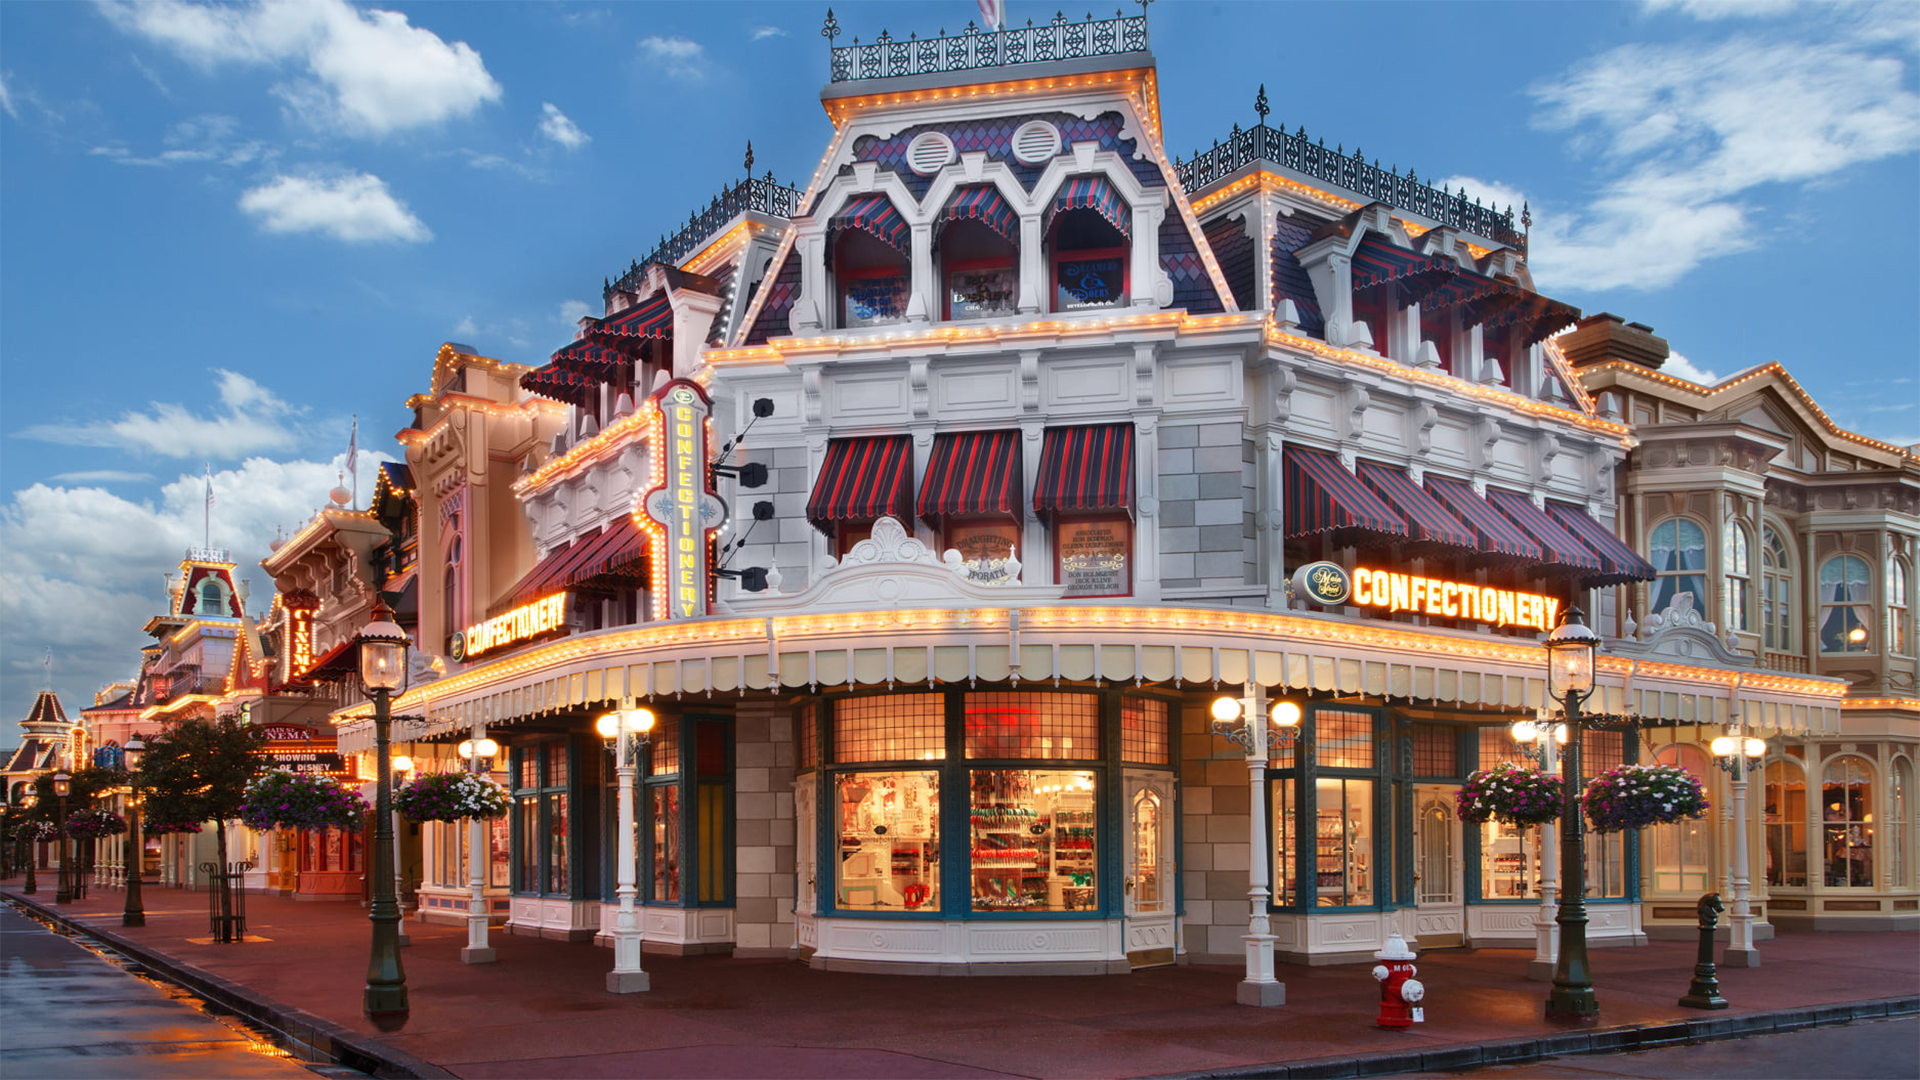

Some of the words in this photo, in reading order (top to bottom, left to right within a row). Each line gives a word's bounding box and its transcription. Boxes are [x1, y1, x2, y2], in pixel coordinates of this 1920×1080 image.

[676, 407, 696, 617] CONFECTIONERY
[956, 535, 1014, 549] DRAUGHTING
[1312, 567, 1342, 583] Main
[1318, 580, 1343, 597] Street
[1353, 568, 1559, 632] CONFECTIONERY
[467, 591, 566, 656] CONFECTIONERY
[293, 609, 311, 676] CINEMA
[248, 731, 310, 740] CNEMA
[273, 754, 317, 762] SHOWING
[279, 763, 292, 771] OF
[297, 763, 331, 772] DISNEY
